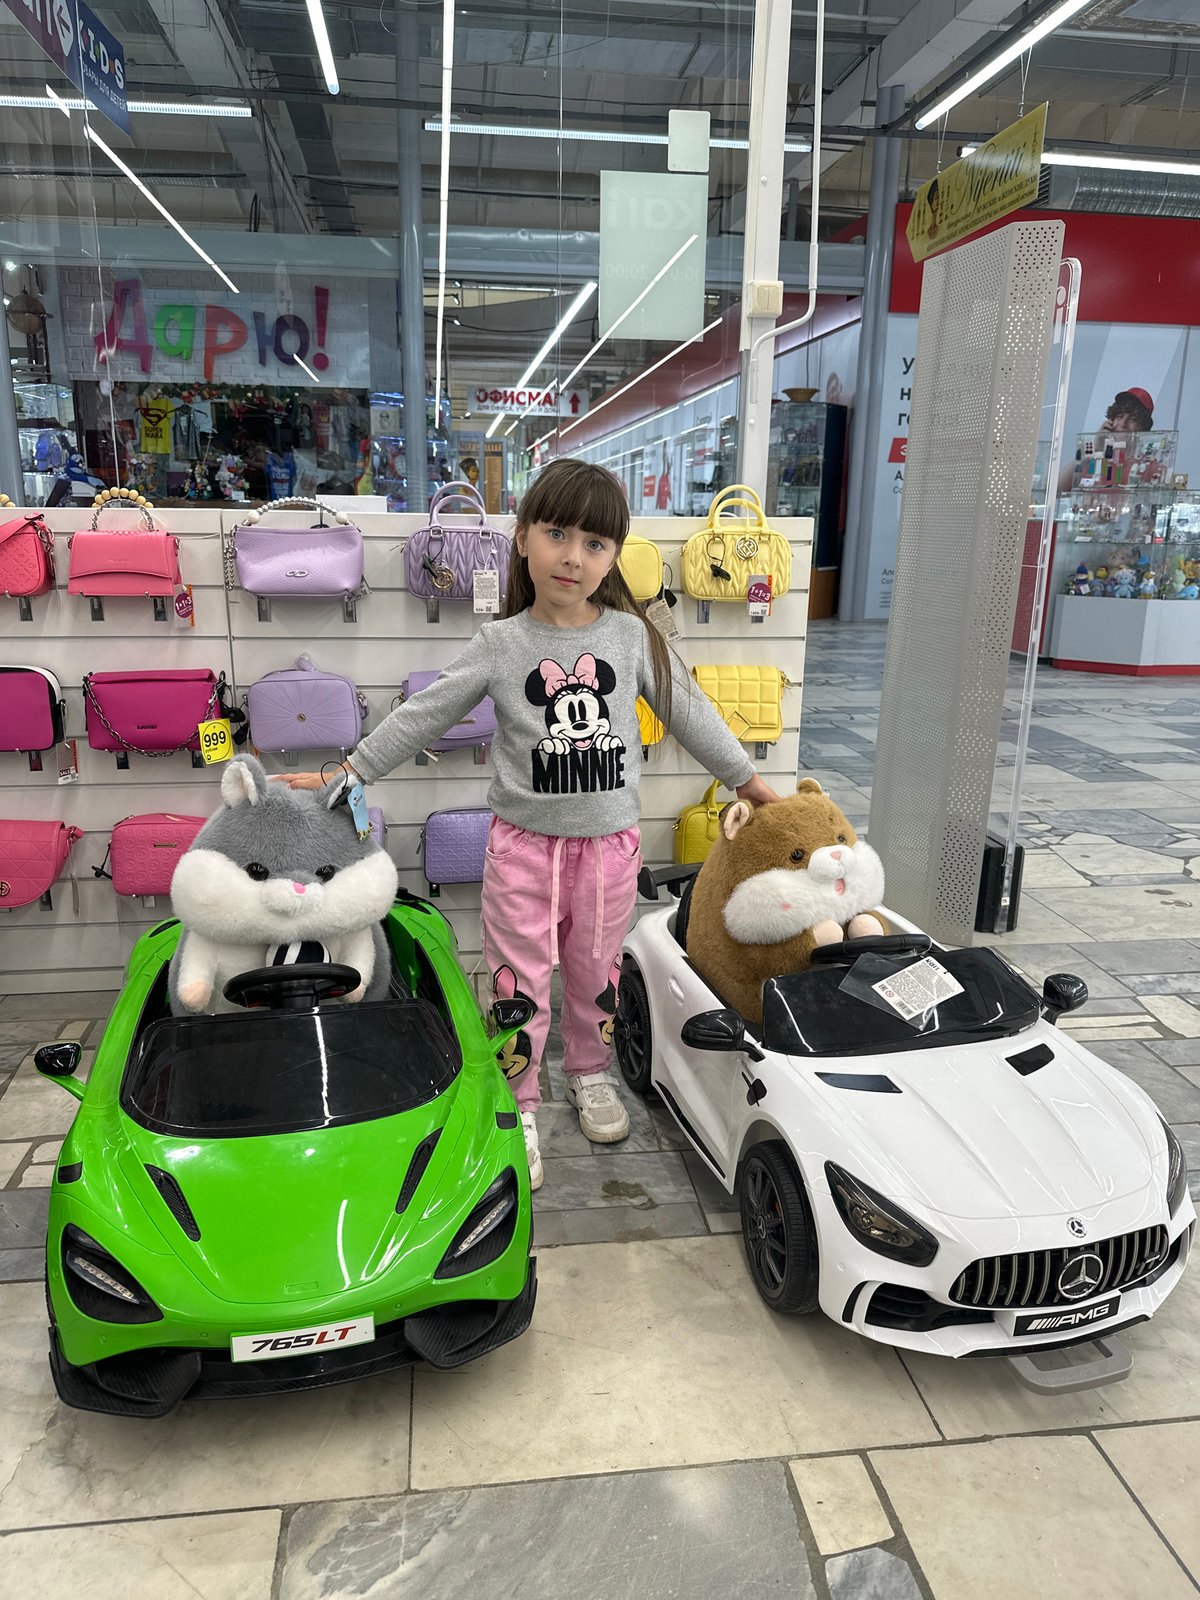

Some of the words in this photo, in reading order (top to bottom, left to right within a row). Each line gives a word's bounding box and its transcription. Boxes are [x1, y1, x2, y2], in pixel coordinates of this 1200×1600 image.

[94, 279, 330, 381] Дарю!
[203, 730, 227, 748] 999
[532, 746, 626, 794] MINNIE
[1056, 1303, 1110, 1328] AMG
[251, 1326, 357, 1354] 765LT
